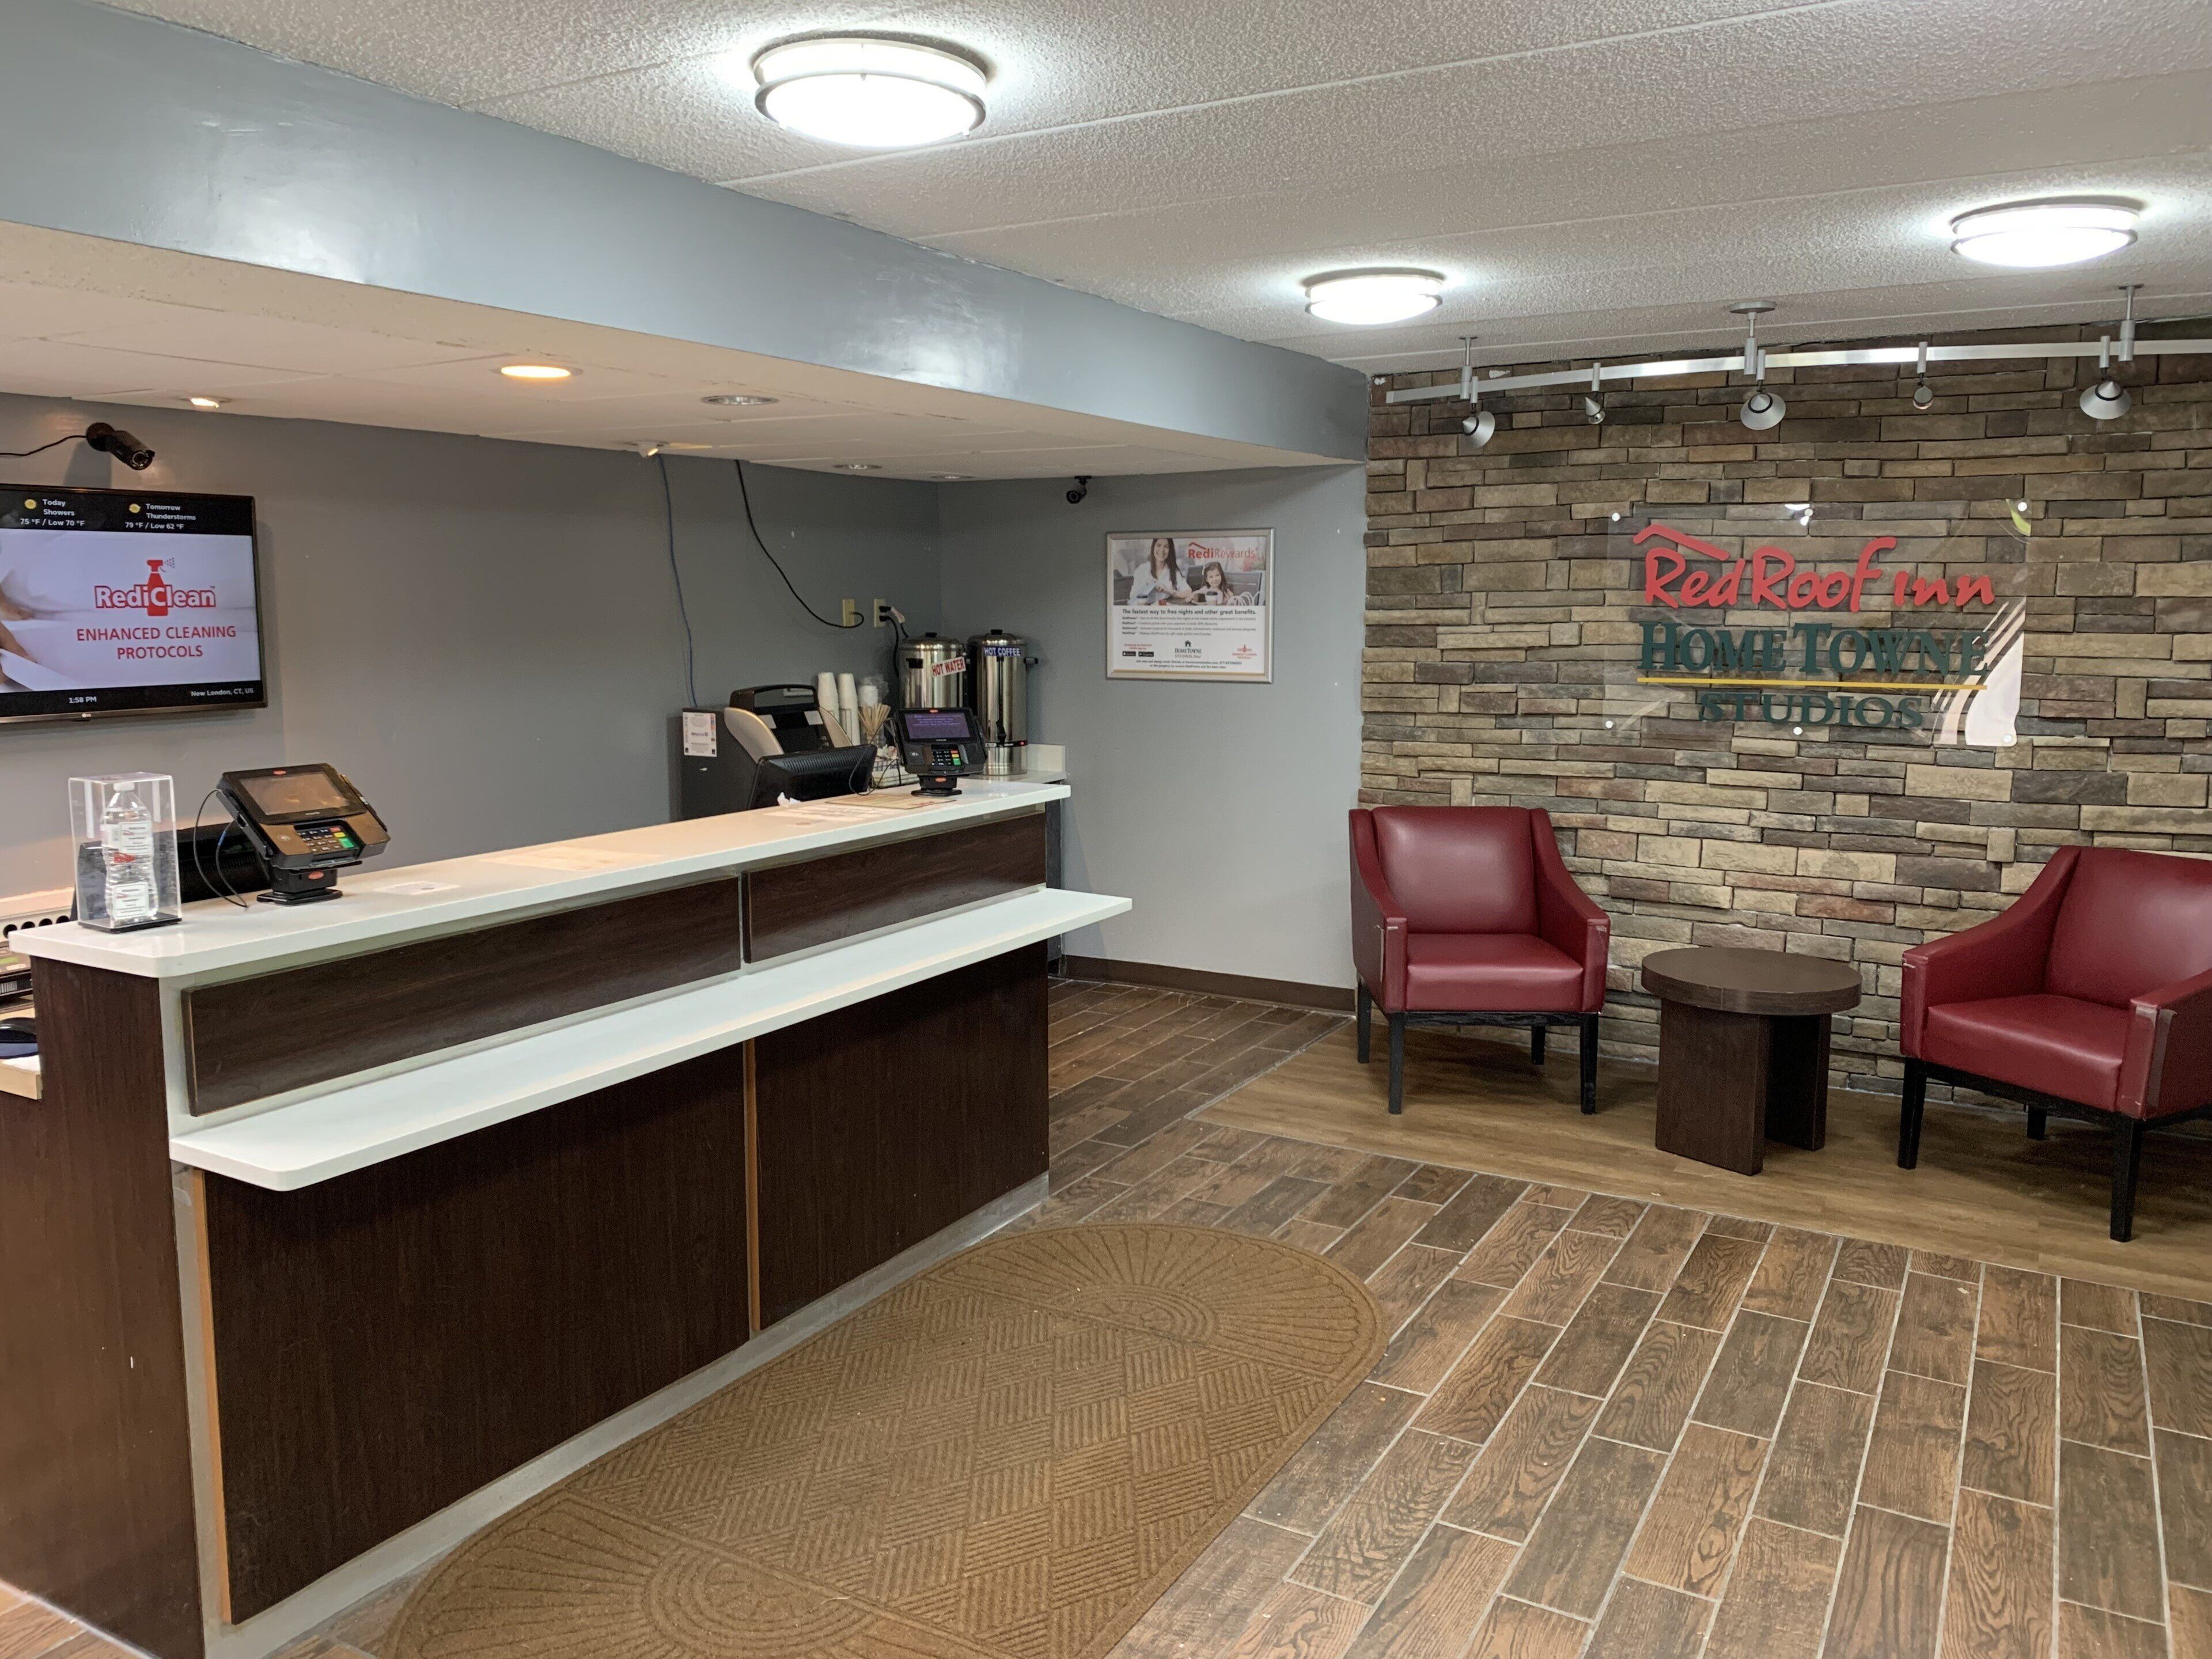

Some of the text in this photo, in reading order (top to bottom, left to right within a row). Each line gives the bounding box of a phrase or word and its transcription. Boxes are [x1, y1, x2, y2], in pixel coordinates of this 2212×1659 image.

[42, 499, 66, 507] Today
[146, 503, 181, 511] Tomorrow
[146, 513, 196, 521] Thunderstorms
[76, 625, 236, 642] ENHANCED CLEANING
[117, 645, 204, 660] PROTOCOLS
[984, 647, 1021, 656] HOT COFFEE
[931, 659, 965, 676] HOT WATER
[1698, 692, 1923, 729] STUDIOS
